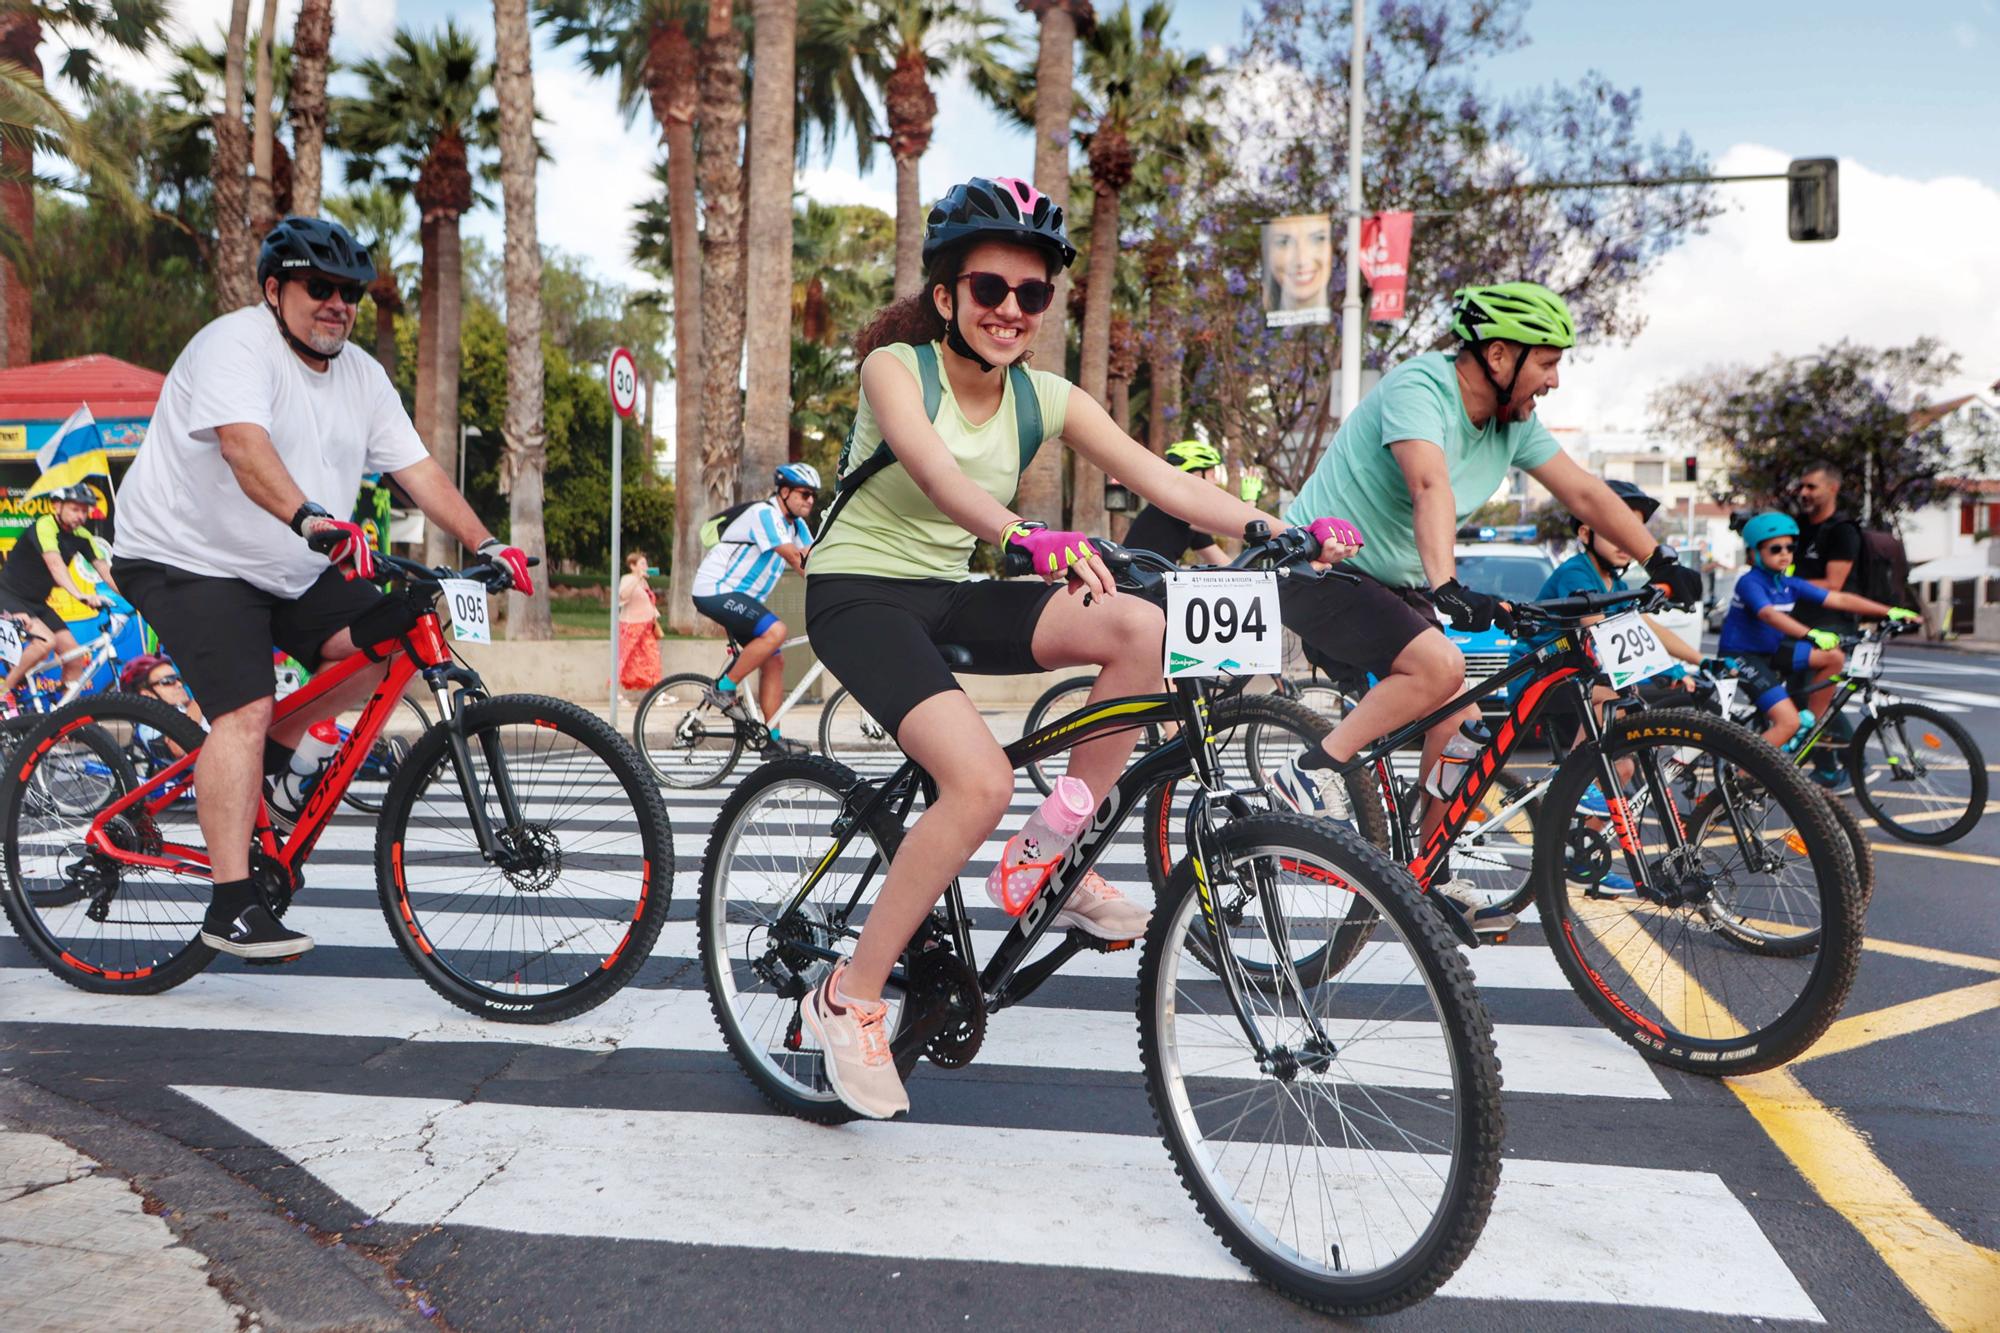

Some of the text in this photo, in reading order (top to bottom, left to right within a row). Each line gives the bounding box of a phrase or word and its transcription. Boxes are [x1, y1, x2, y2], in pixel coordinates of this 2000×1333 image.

[617, 370, 632, 394] 30
[455, 594, 484, 624] 095
[1185, 596, 1267, 644] 094
[1610, 625, 1656, 665] 299
[1627, 727, 1704, 741] MAXXIS
[308, 693, 384, 818] ORBEA
[1408, 668, 1580, 885] SCOTT
[1020, 784, 1121, 938] B-PRO
[485, 1000, 534, 1011] KENDA
